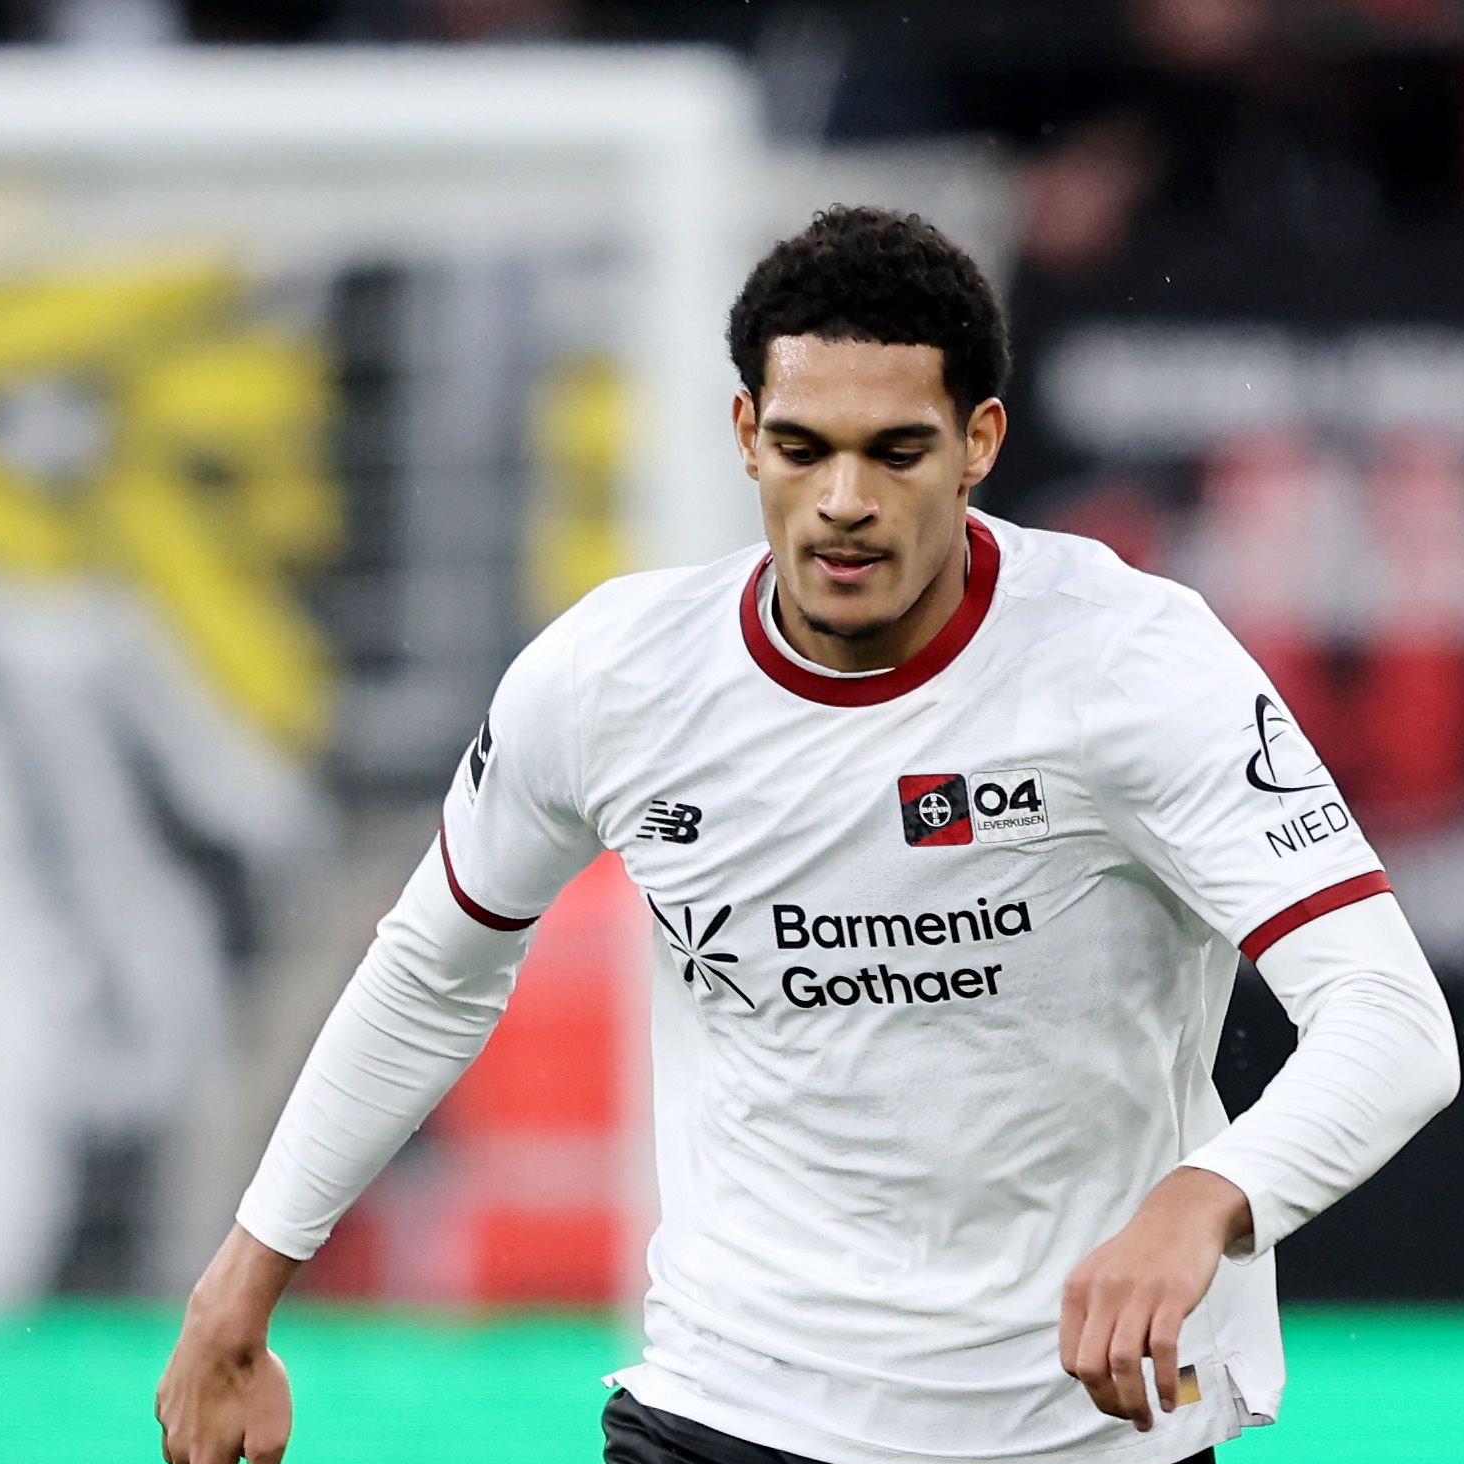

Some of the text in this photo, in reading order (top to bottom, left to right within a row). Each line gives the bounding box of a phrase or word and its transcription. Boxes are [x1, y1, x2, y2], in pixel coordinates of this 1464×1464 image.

[973, 778, 1042, 817] 04
[977, 815, 1046, 831] LEVERKUSEN
[772, 896, 1033, 950] Barmenia
[781, 963, 1003, 1009] Gothaer
